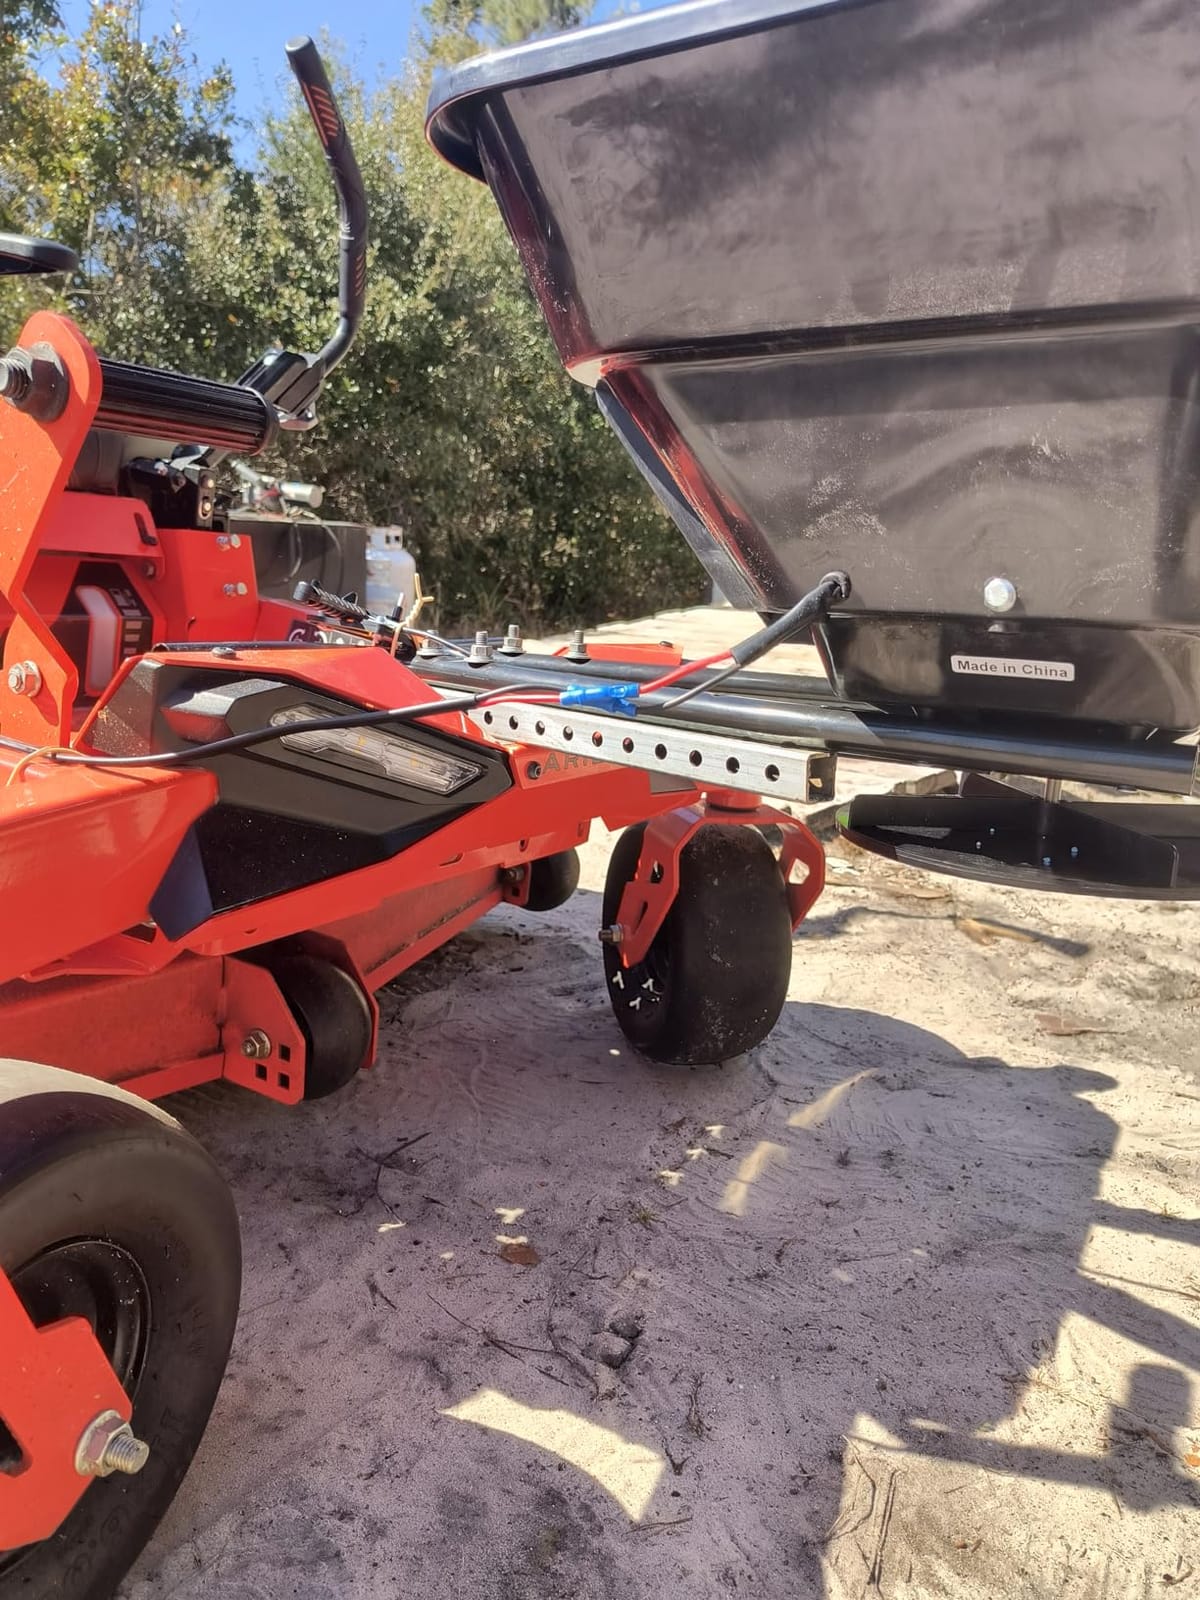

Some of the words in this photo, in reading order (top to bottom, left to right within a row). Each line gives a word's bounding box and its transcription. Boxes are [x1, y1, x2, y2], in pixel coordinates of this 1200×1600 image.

[957, 660, 998, 672] Made
[1003, 662, 1017, 673] in
[1022, 664, 1068, 678] China
